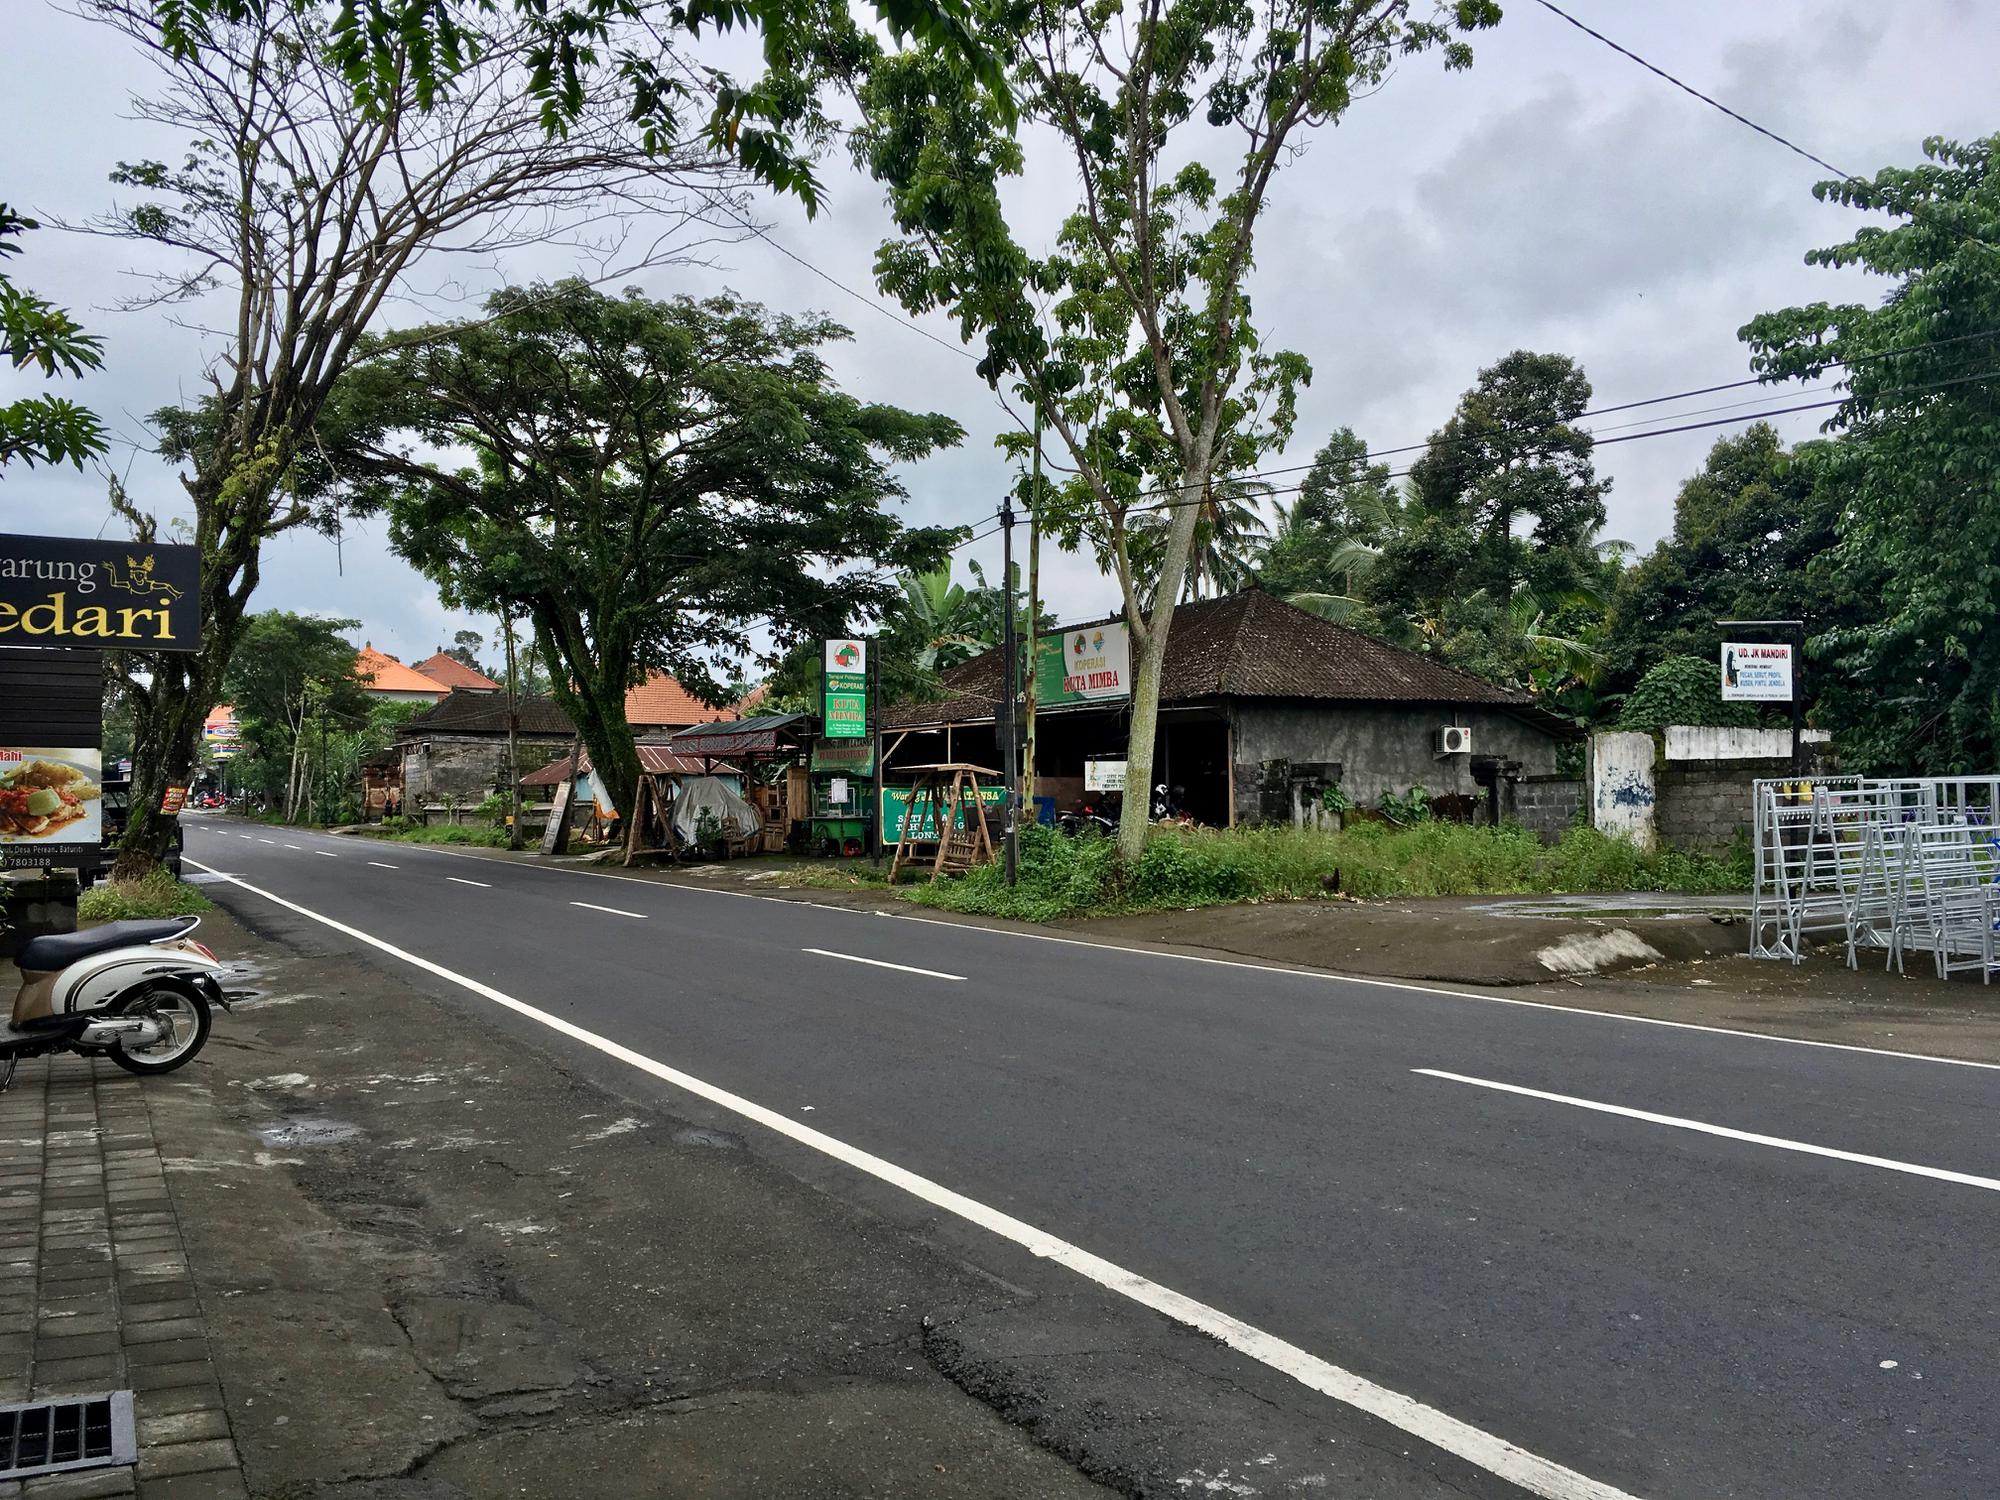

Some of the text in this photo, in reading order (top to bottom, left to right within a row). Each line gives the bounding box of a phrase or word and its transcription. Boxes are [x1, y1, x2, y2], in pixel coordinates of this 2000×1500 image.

[0, 557, 97, 594] arung
[1738, 648, 1788, 660] UD. JK MANDIRI
[1074, 656, 1106, 672] KOPERASI
[839, 682, 865, 690] KOPERASI
[1063, 674, 1087, 693] KUTA
[1088, 670, 1119, 691] MIMBA
[833, 699, 860, 709] KUTA
[829, 710, 864, 721] MIMBA
[14, 846, 31, 854] Desa
[10, 858, 51, 867] 7803188
